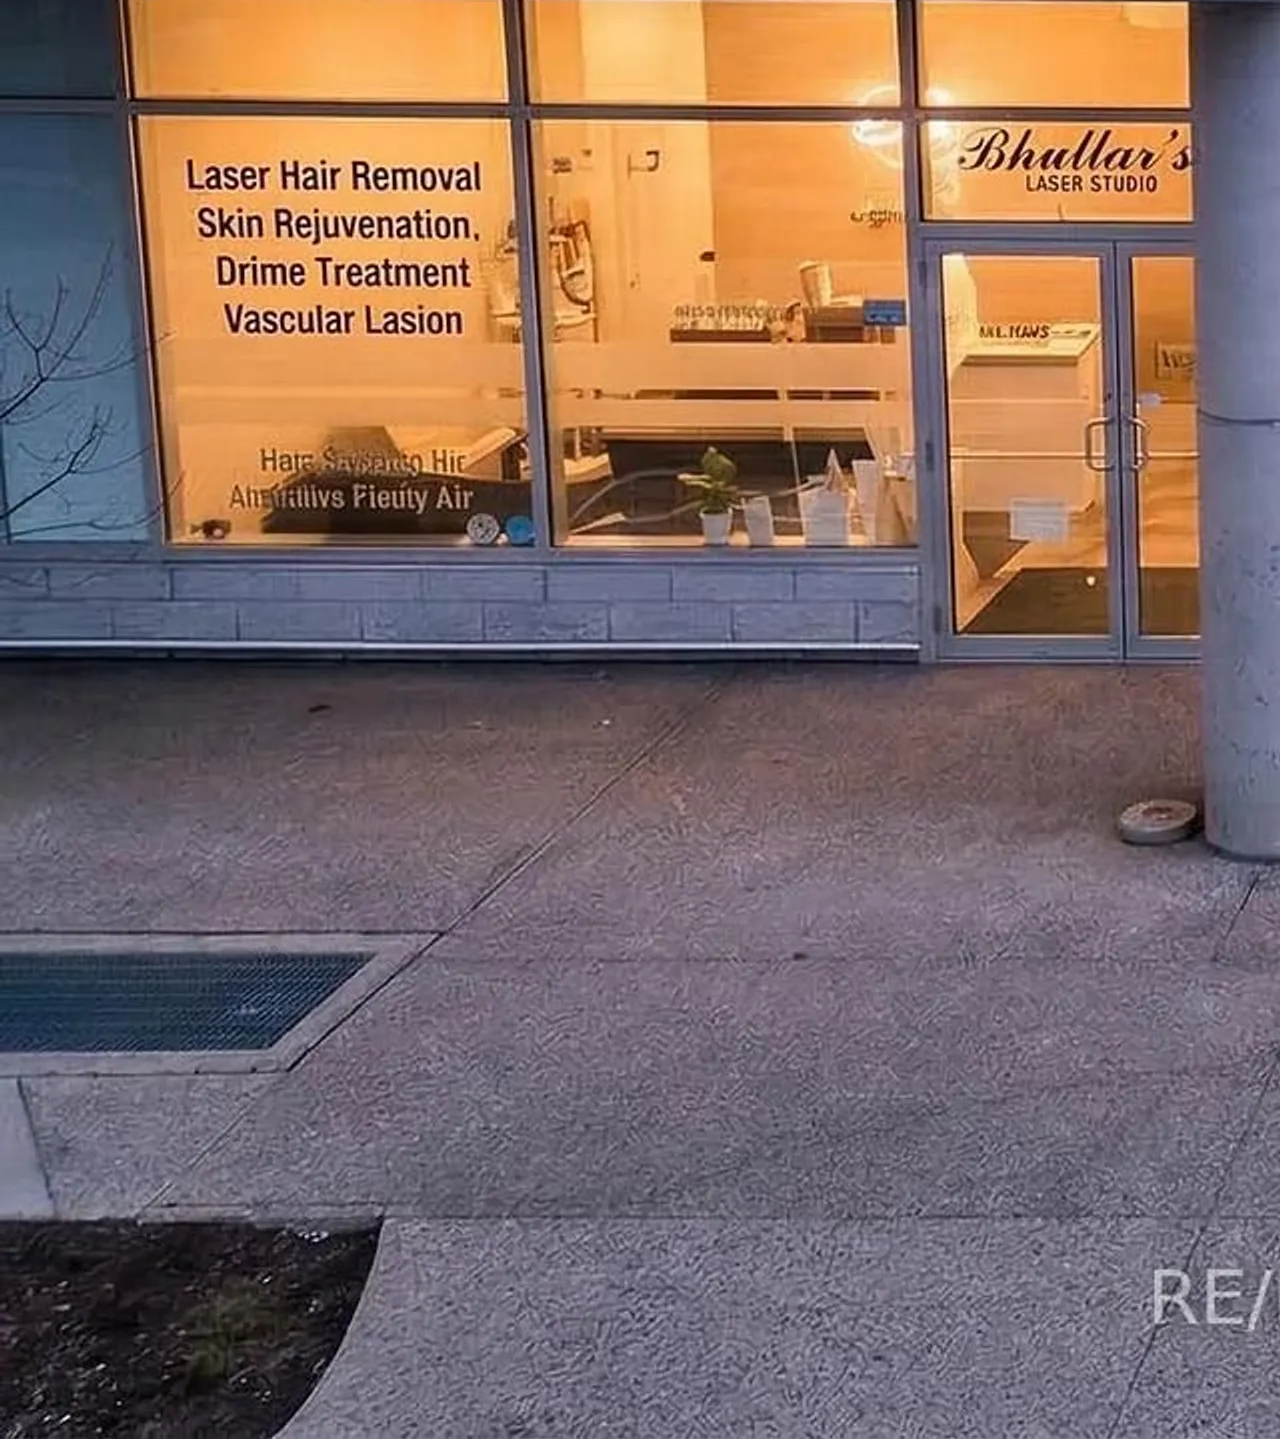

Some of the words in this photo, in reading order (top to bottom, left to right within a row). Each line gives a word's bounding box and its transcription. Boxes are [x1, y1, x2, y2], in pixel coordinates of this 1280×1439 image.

[958, 127, 1192, 171] Bhullar's
[186, 159, 271, 190] Laser
[280, 160, 341, 190] Hair
[352, 161, 480, 191] Removal
[1026, 175, 1083, 192] LASER
[1090, 175, 1157, 193] STUDIO
[198, 208, 263, 238] Skin
[216, 256, 305, 286] Drime
[314, 257, 471, 288] Treatment
[224, 304, 355, 334] Vascular
[365, 305, 463, 334] Lasion
[436, 484, 474, 510] Air
